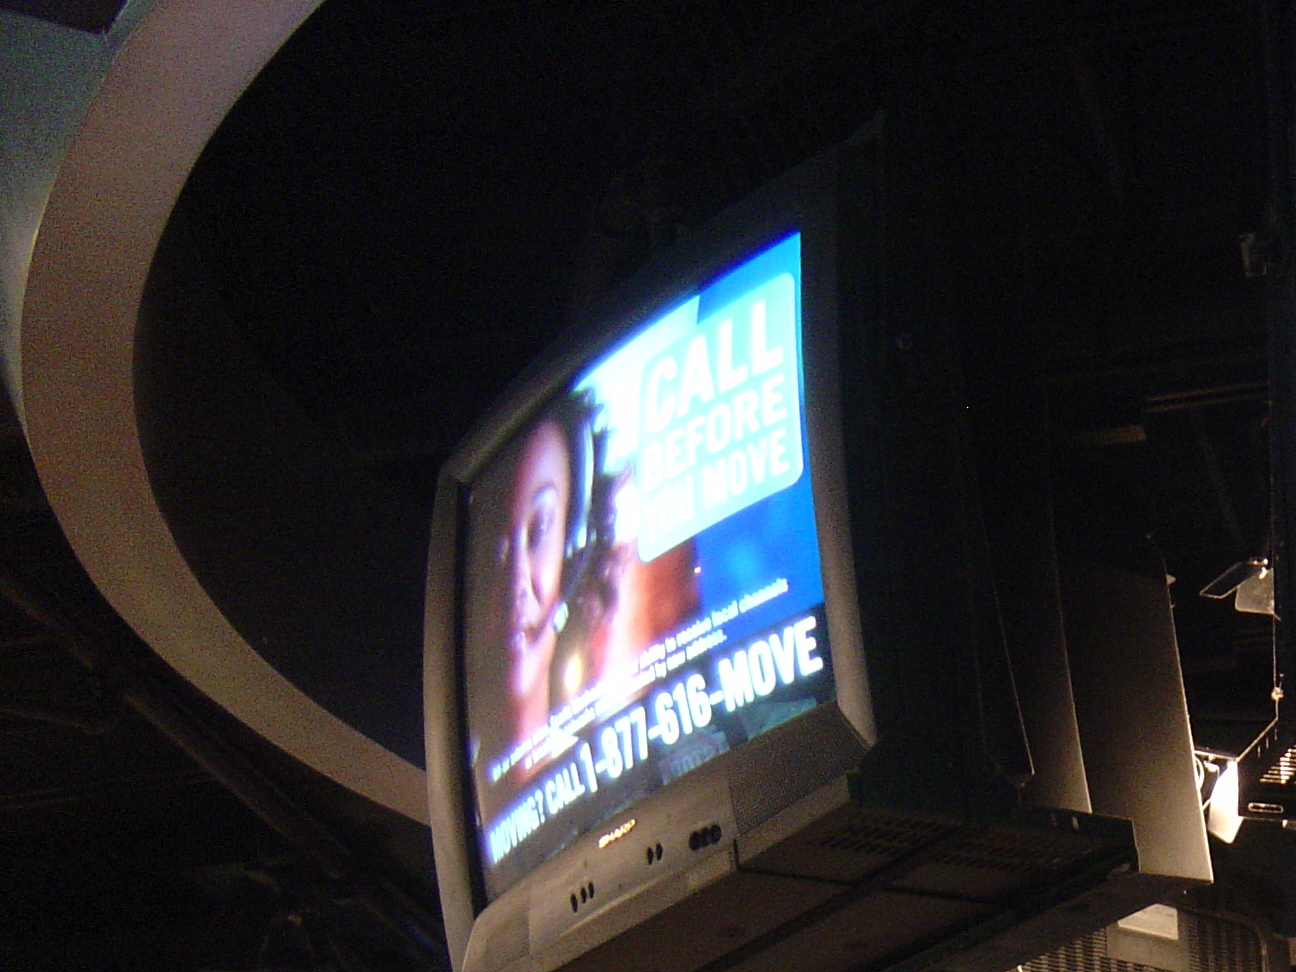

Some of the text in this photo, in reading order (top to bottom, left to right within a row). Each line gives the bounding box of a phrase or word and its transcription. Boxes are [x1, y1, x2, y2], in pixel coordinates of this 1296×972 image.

[645, 298, 785, 434] CALL
[642, 372, 788, 492] BEFORE
[701, 426, 791, 510] MOVE
[490, 789, 546, 863] MOVING?
[545, 762, 585, 815] CALL
[579, 615, 824, 793] 1-877-616-MOVE
